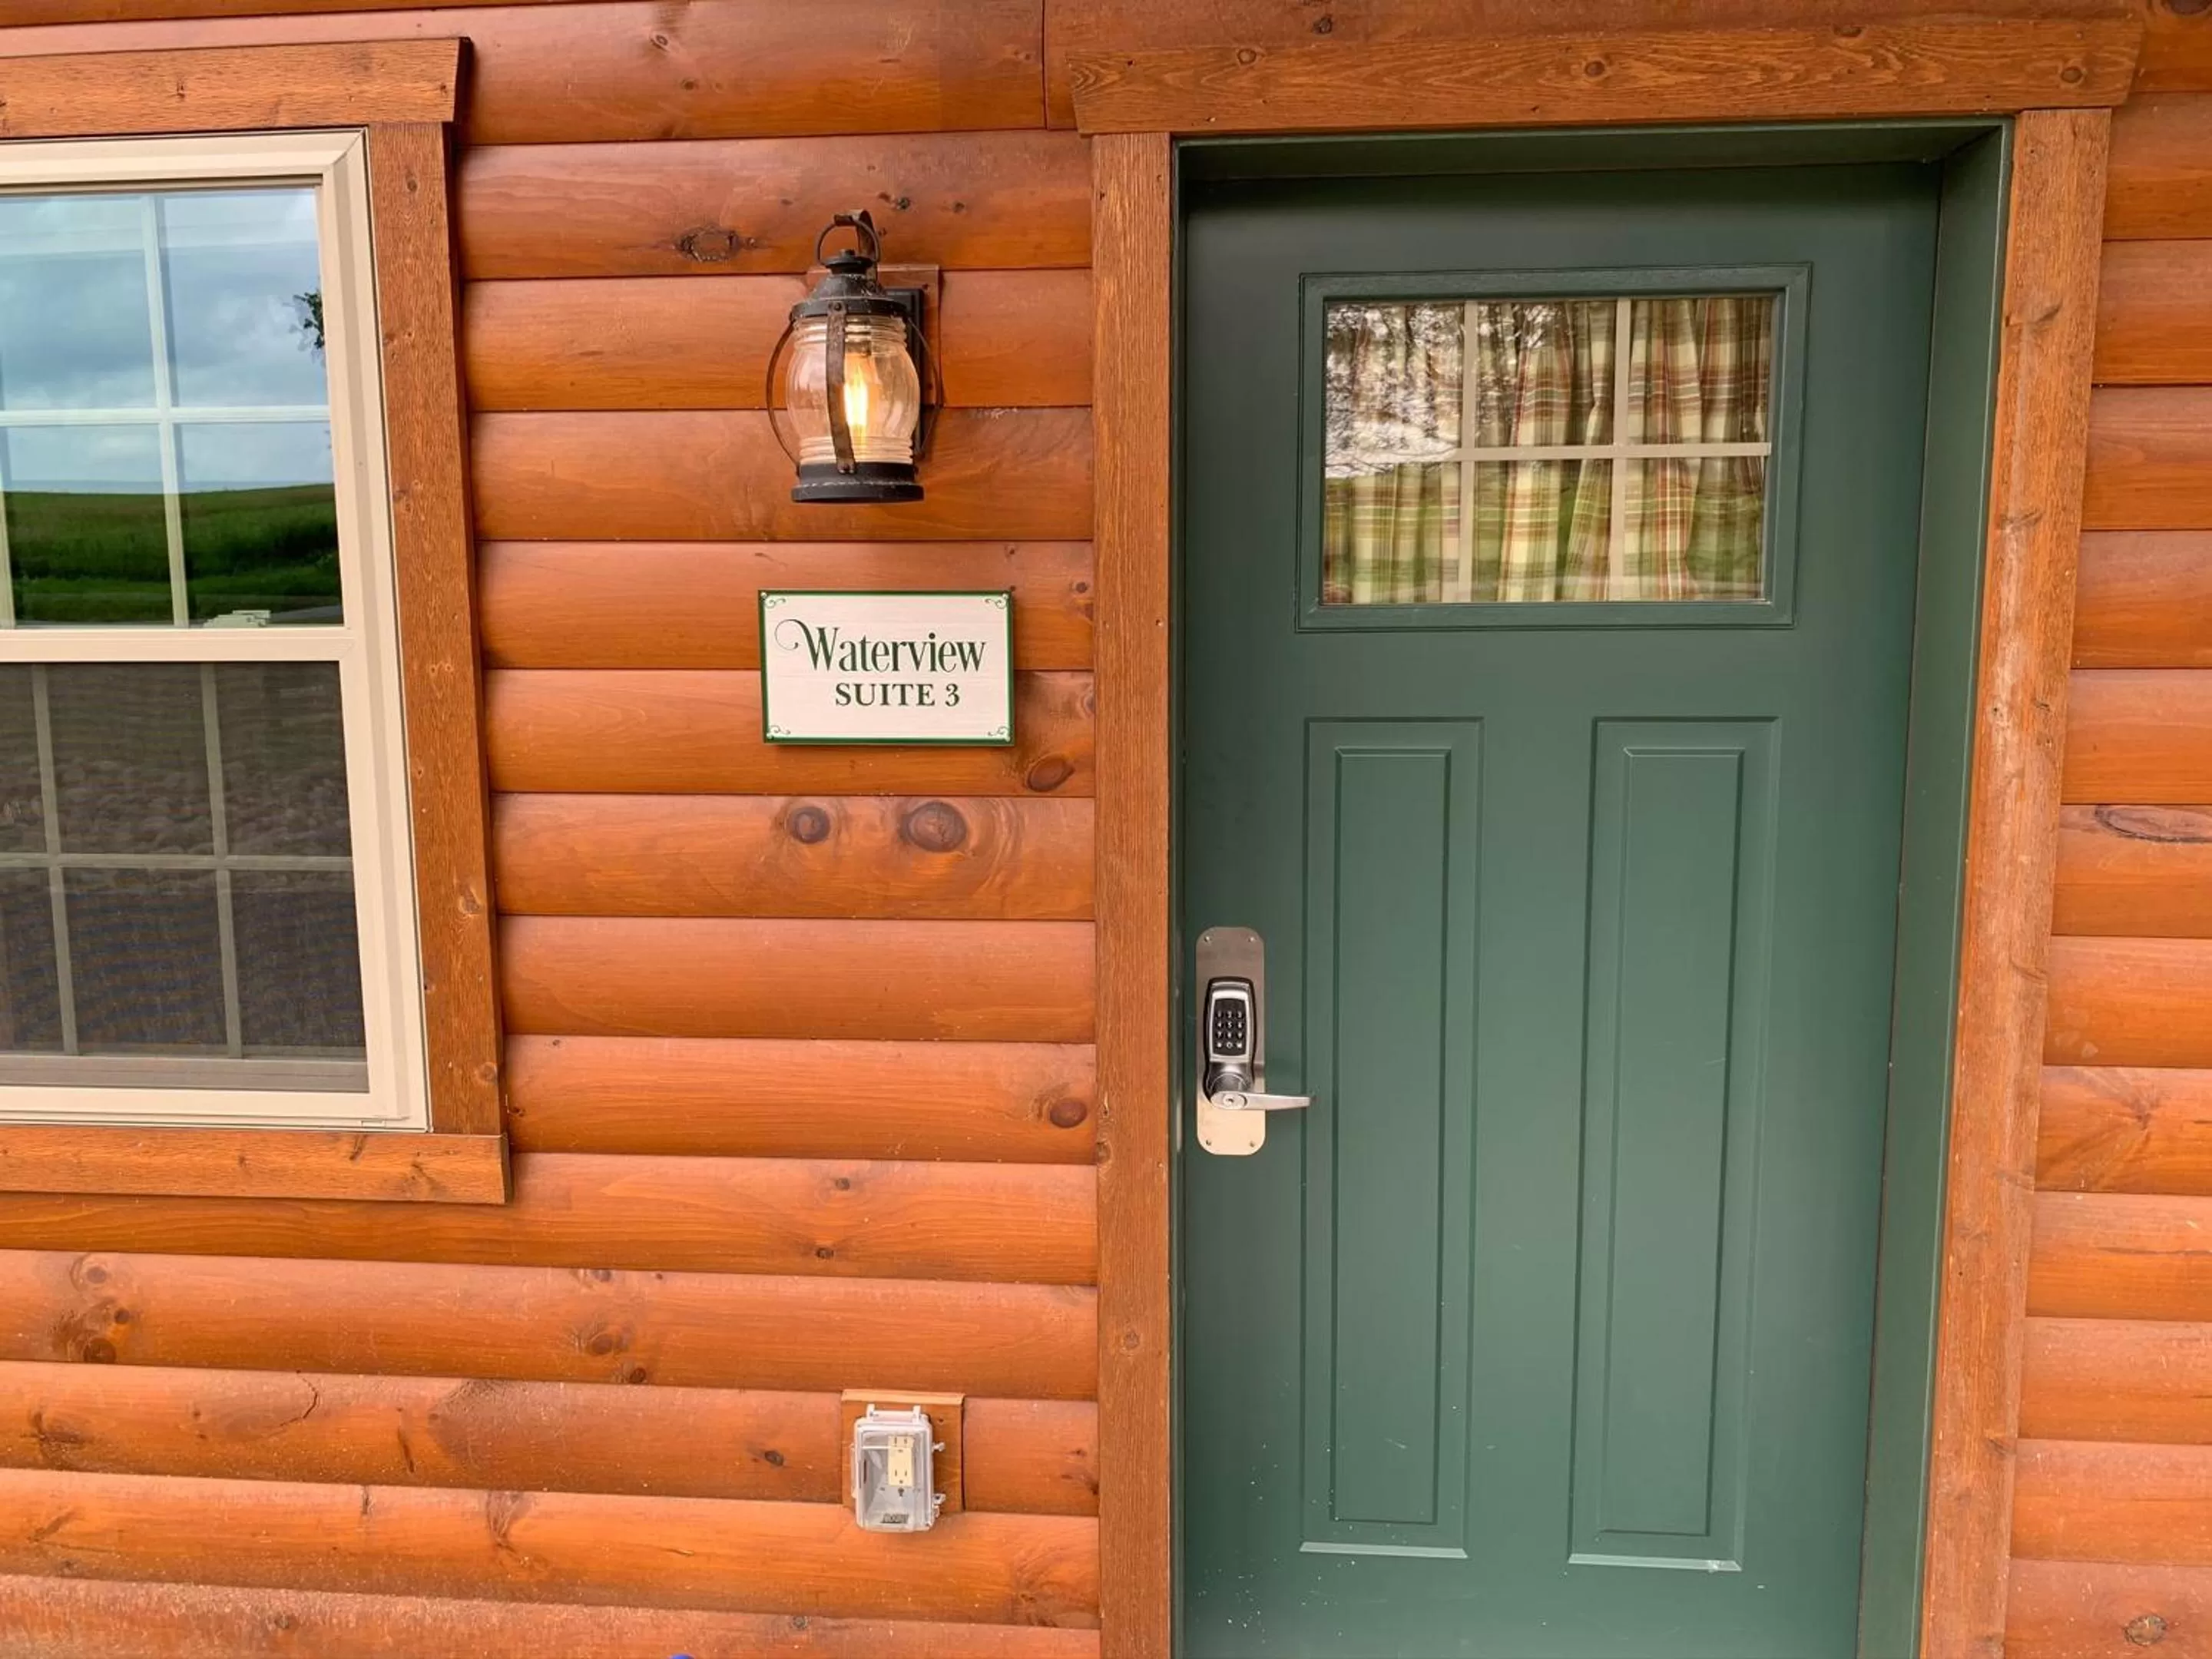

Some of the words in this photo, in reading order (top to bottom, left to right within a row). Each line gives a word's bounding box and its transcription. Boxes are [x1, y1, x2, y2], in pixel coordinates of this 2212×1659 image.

[774, 619, 985, 672] Waterview
[836, 683, 935, 707] SUITE
[945, 684, 959, 707] 3
